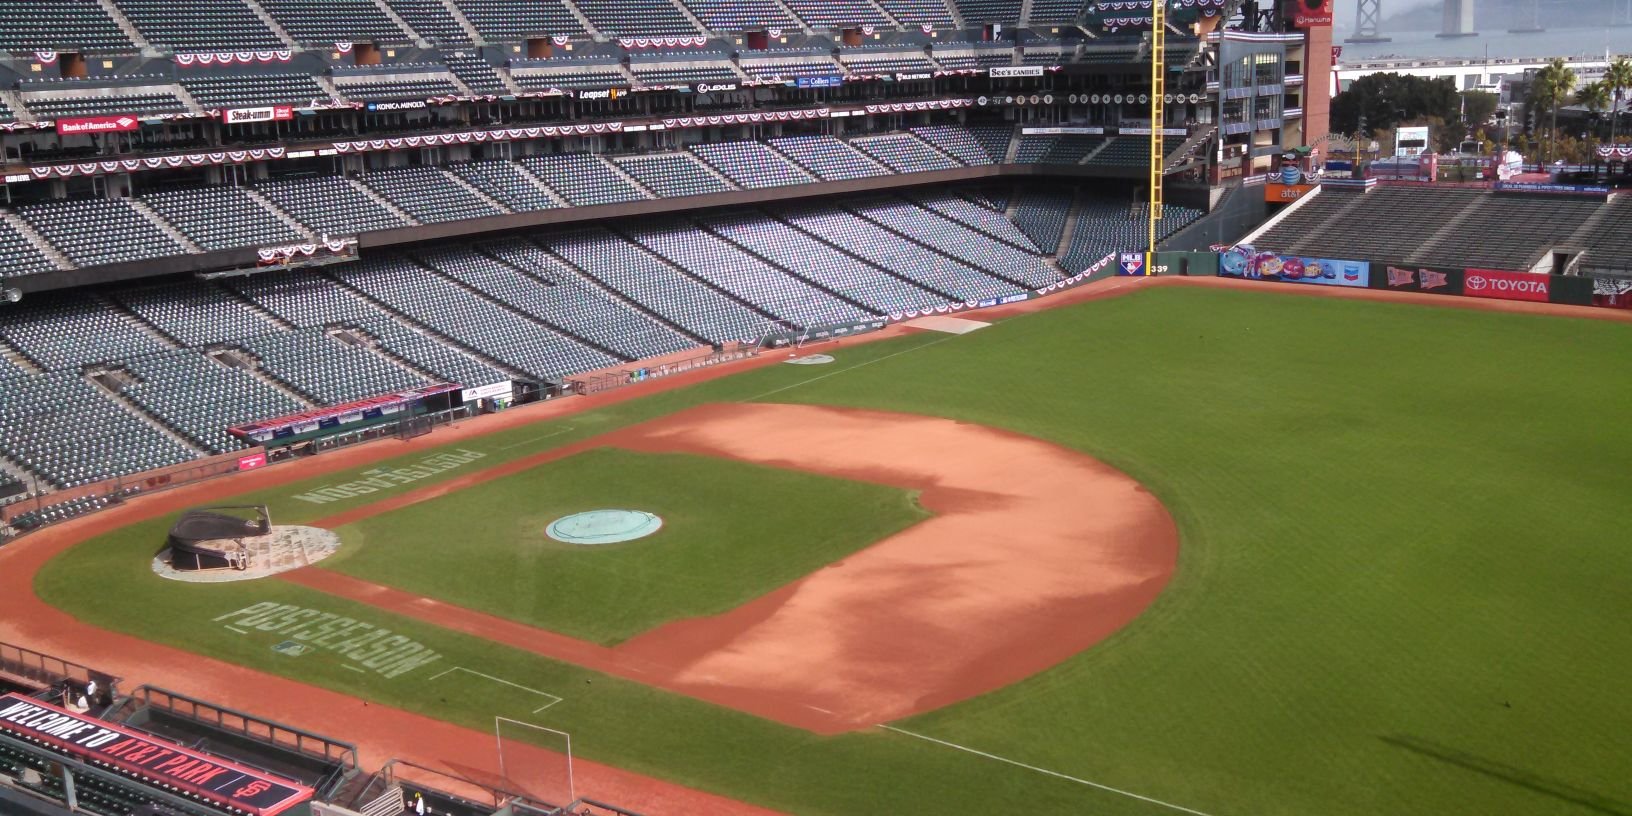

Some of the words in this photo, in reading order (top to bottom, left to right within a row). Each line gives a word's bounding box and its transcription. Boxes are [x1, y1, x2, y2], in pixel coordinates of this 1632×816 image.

[991, 68, 1011, 76] See's
[707, 83, 736, 91] LEXUS
[580, 89, 609, 100] Leapset
[376, 102, 400, 110] KONICA
[400, 101, 426, 109] MINOLTA
[231, 109, 271, 121] Steak-umm
[62, 123, 81, 131] Bank
[81, 122, 88, 130] of
[88, 121, 117, 130] America
[1281, 189, 1302, 198] at&t
[1151, 265, 1168, 273] 339
[1489, 278, 1547, 293] TOYOTA
[291, 448, 487, 504] POSTSEASON
[212, 601, 443, 679] POSTSEASON
[0, 701, 96, 740] WELCOME
[76, 728, 120, 748] TO
[101, 738, 173, 765] AT&T
[153, 754, 229, 785] PARK
